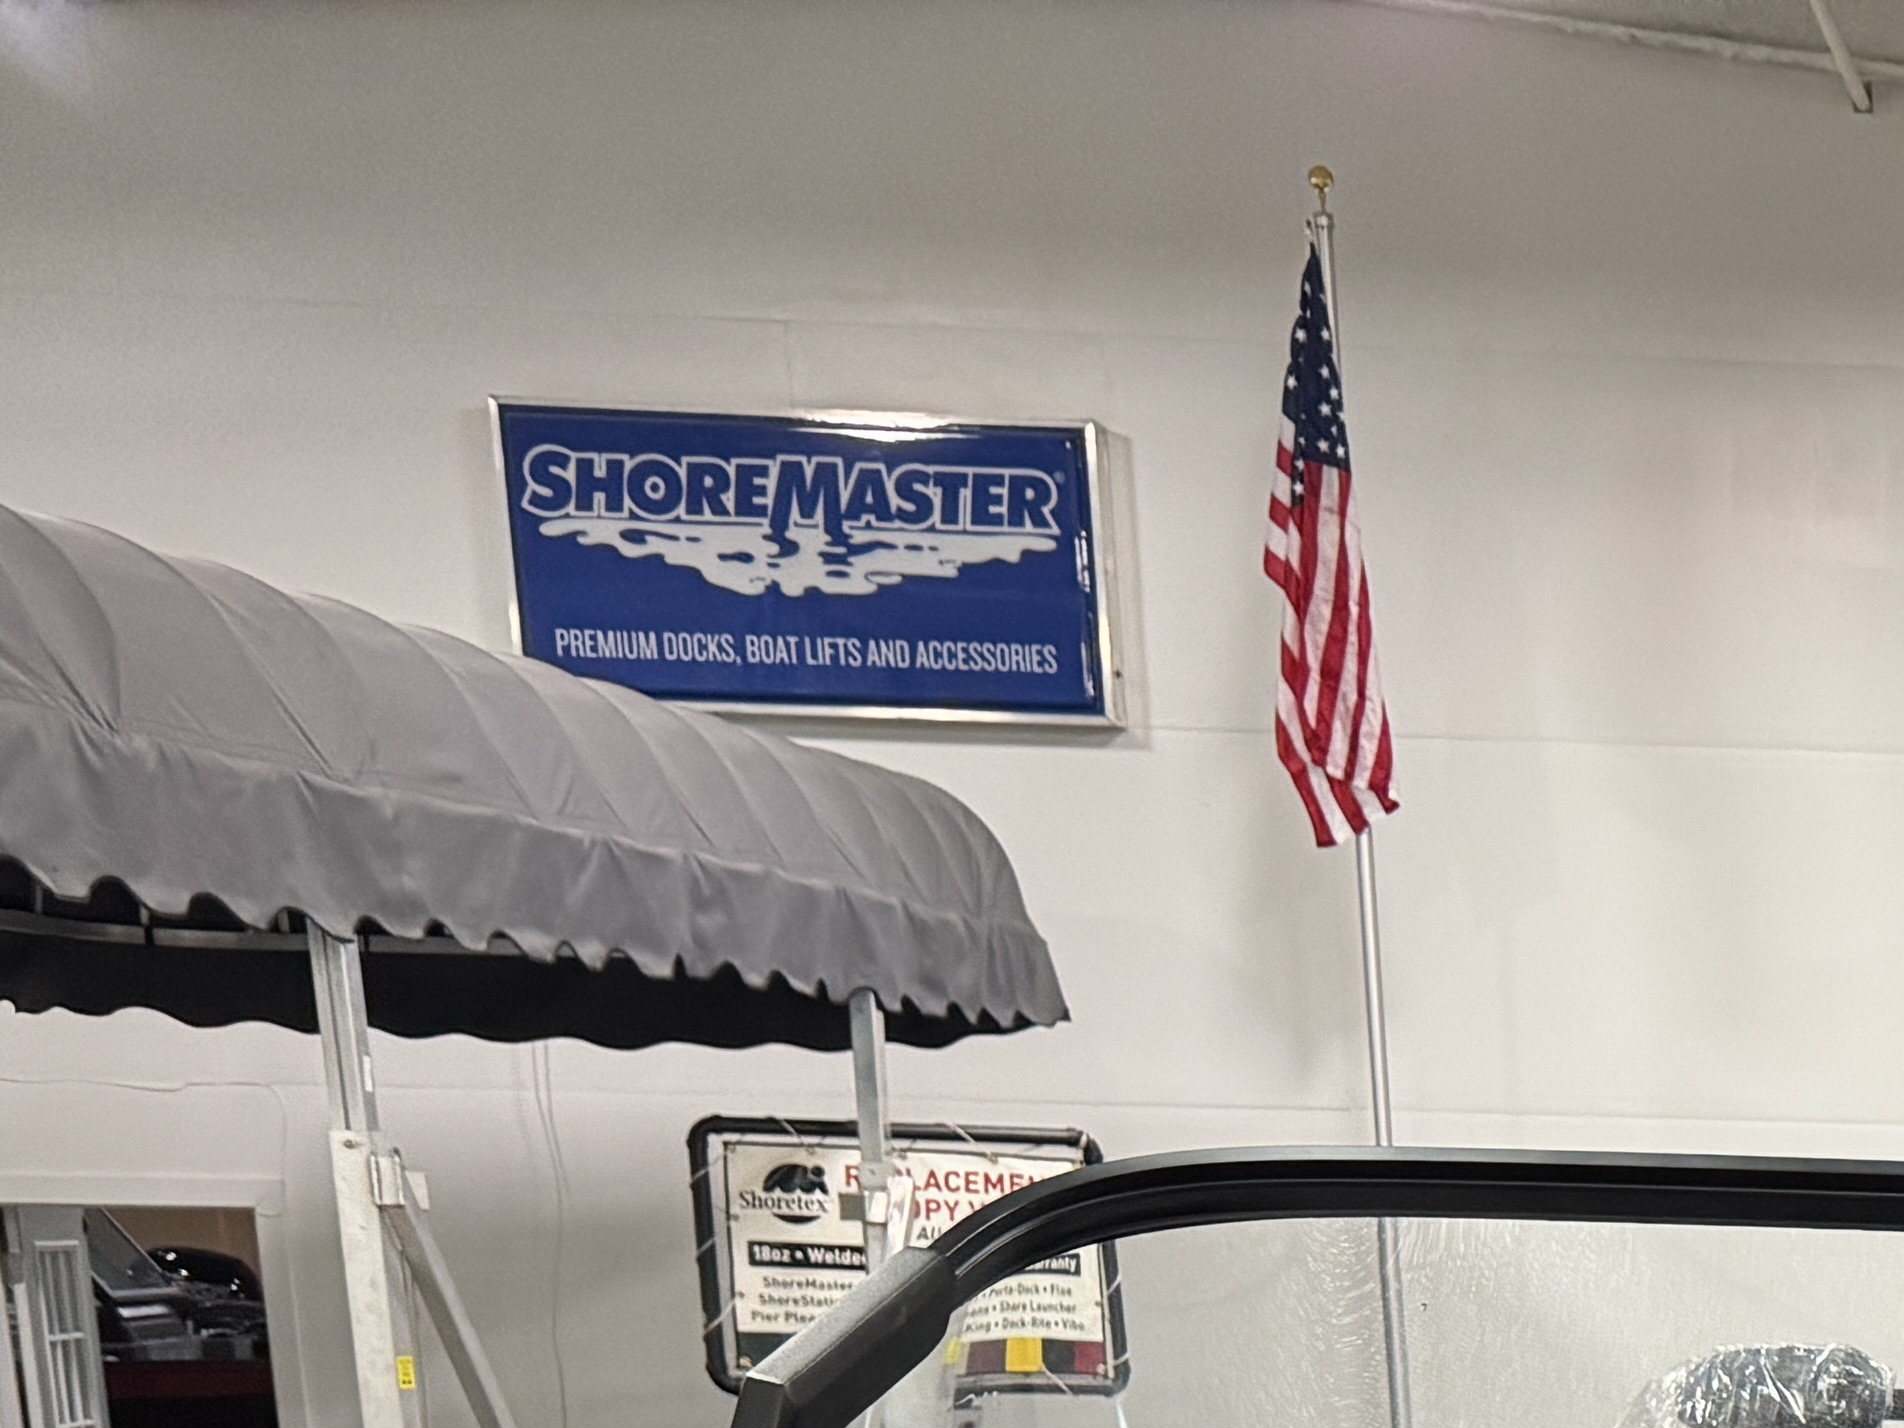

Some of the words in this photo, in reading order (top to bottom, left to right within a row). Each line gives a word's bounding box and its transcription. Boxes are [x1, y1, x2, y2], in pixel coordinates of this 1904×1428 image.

[521, 444, 1061, 535] SHOREMASTER
[554, 628, 658, 661] PREMIUM
[663, 632, 741, 666] DOCKS,
[746, 635, 799, 665] BOAT
[805, 637, 862, 668] LIFTS
[867, 639, 911, 670] AND
[915, 640, 1058, 675] ACCESSORIES
[738, 1188, 829, 1214] Shoretex
[752, 1244, 792, 1263] 18oz
